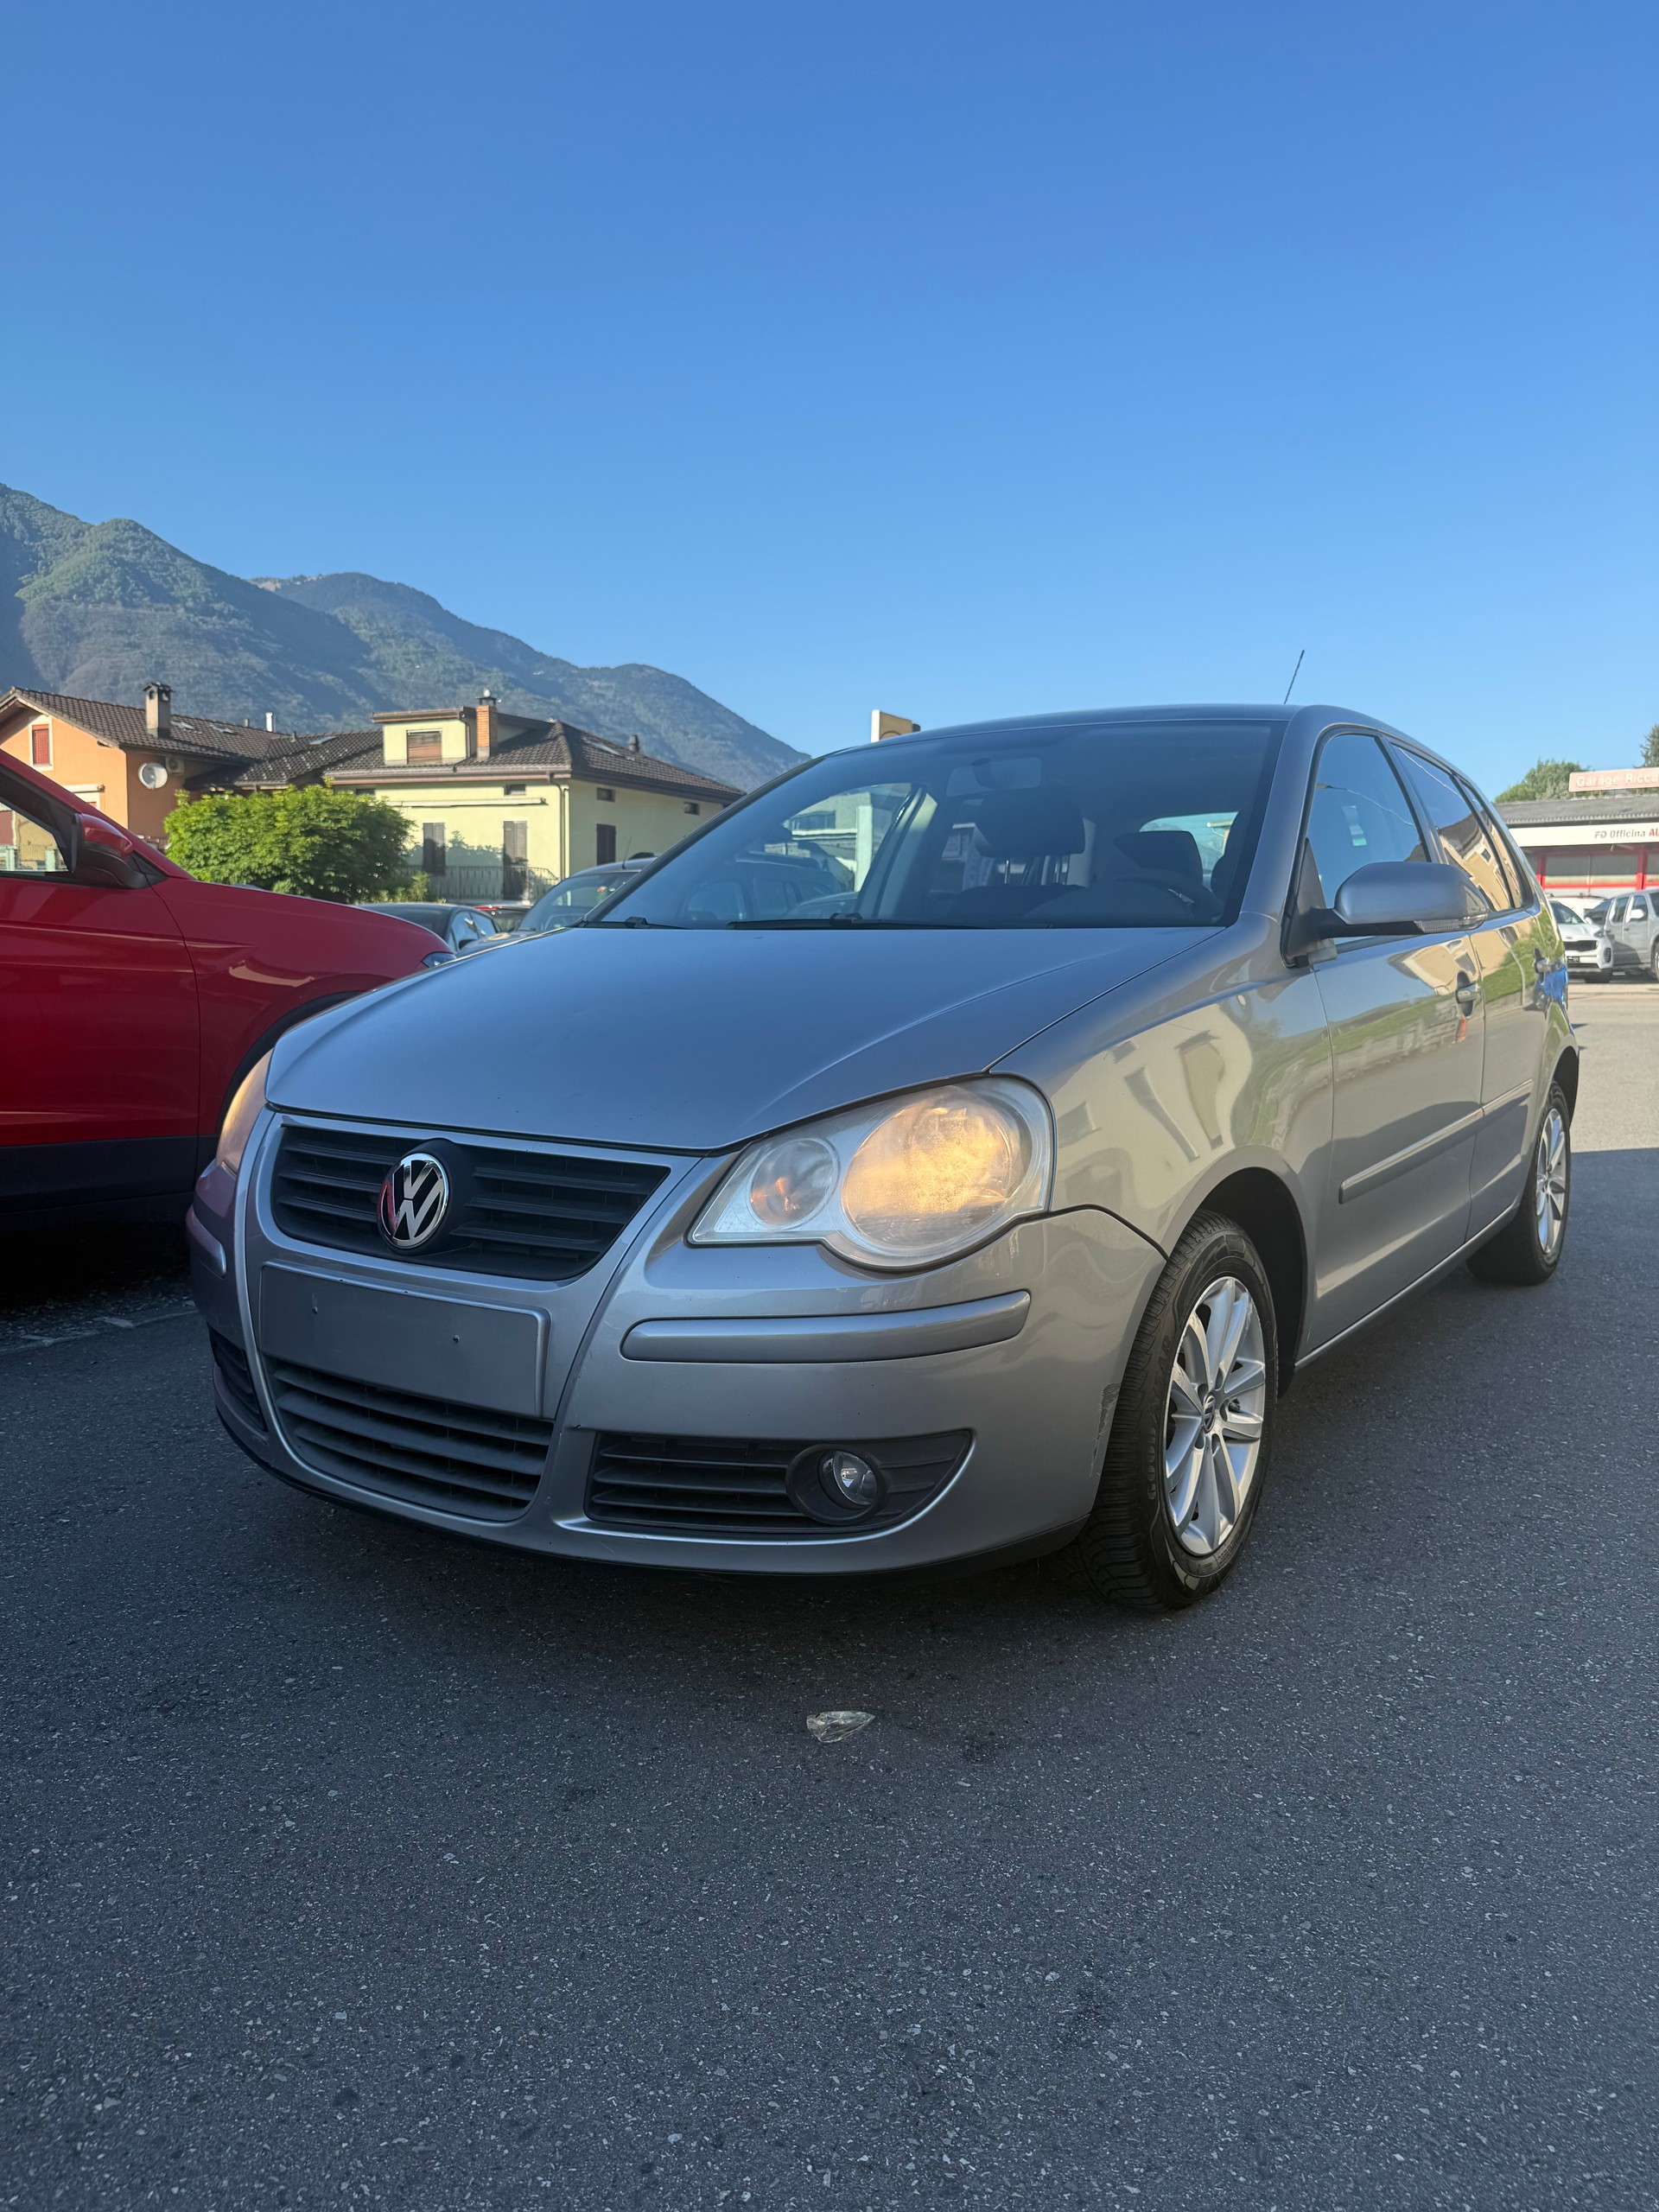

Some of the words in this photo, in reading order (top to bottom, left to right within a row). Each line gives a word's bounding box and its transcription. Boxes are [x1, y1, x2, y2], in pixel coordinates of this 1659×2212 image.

[1576, 774, 1618, 788] Garage
[1610, 829, 1646, 839] Officina
[378, 1153, 449, 1249] VW
